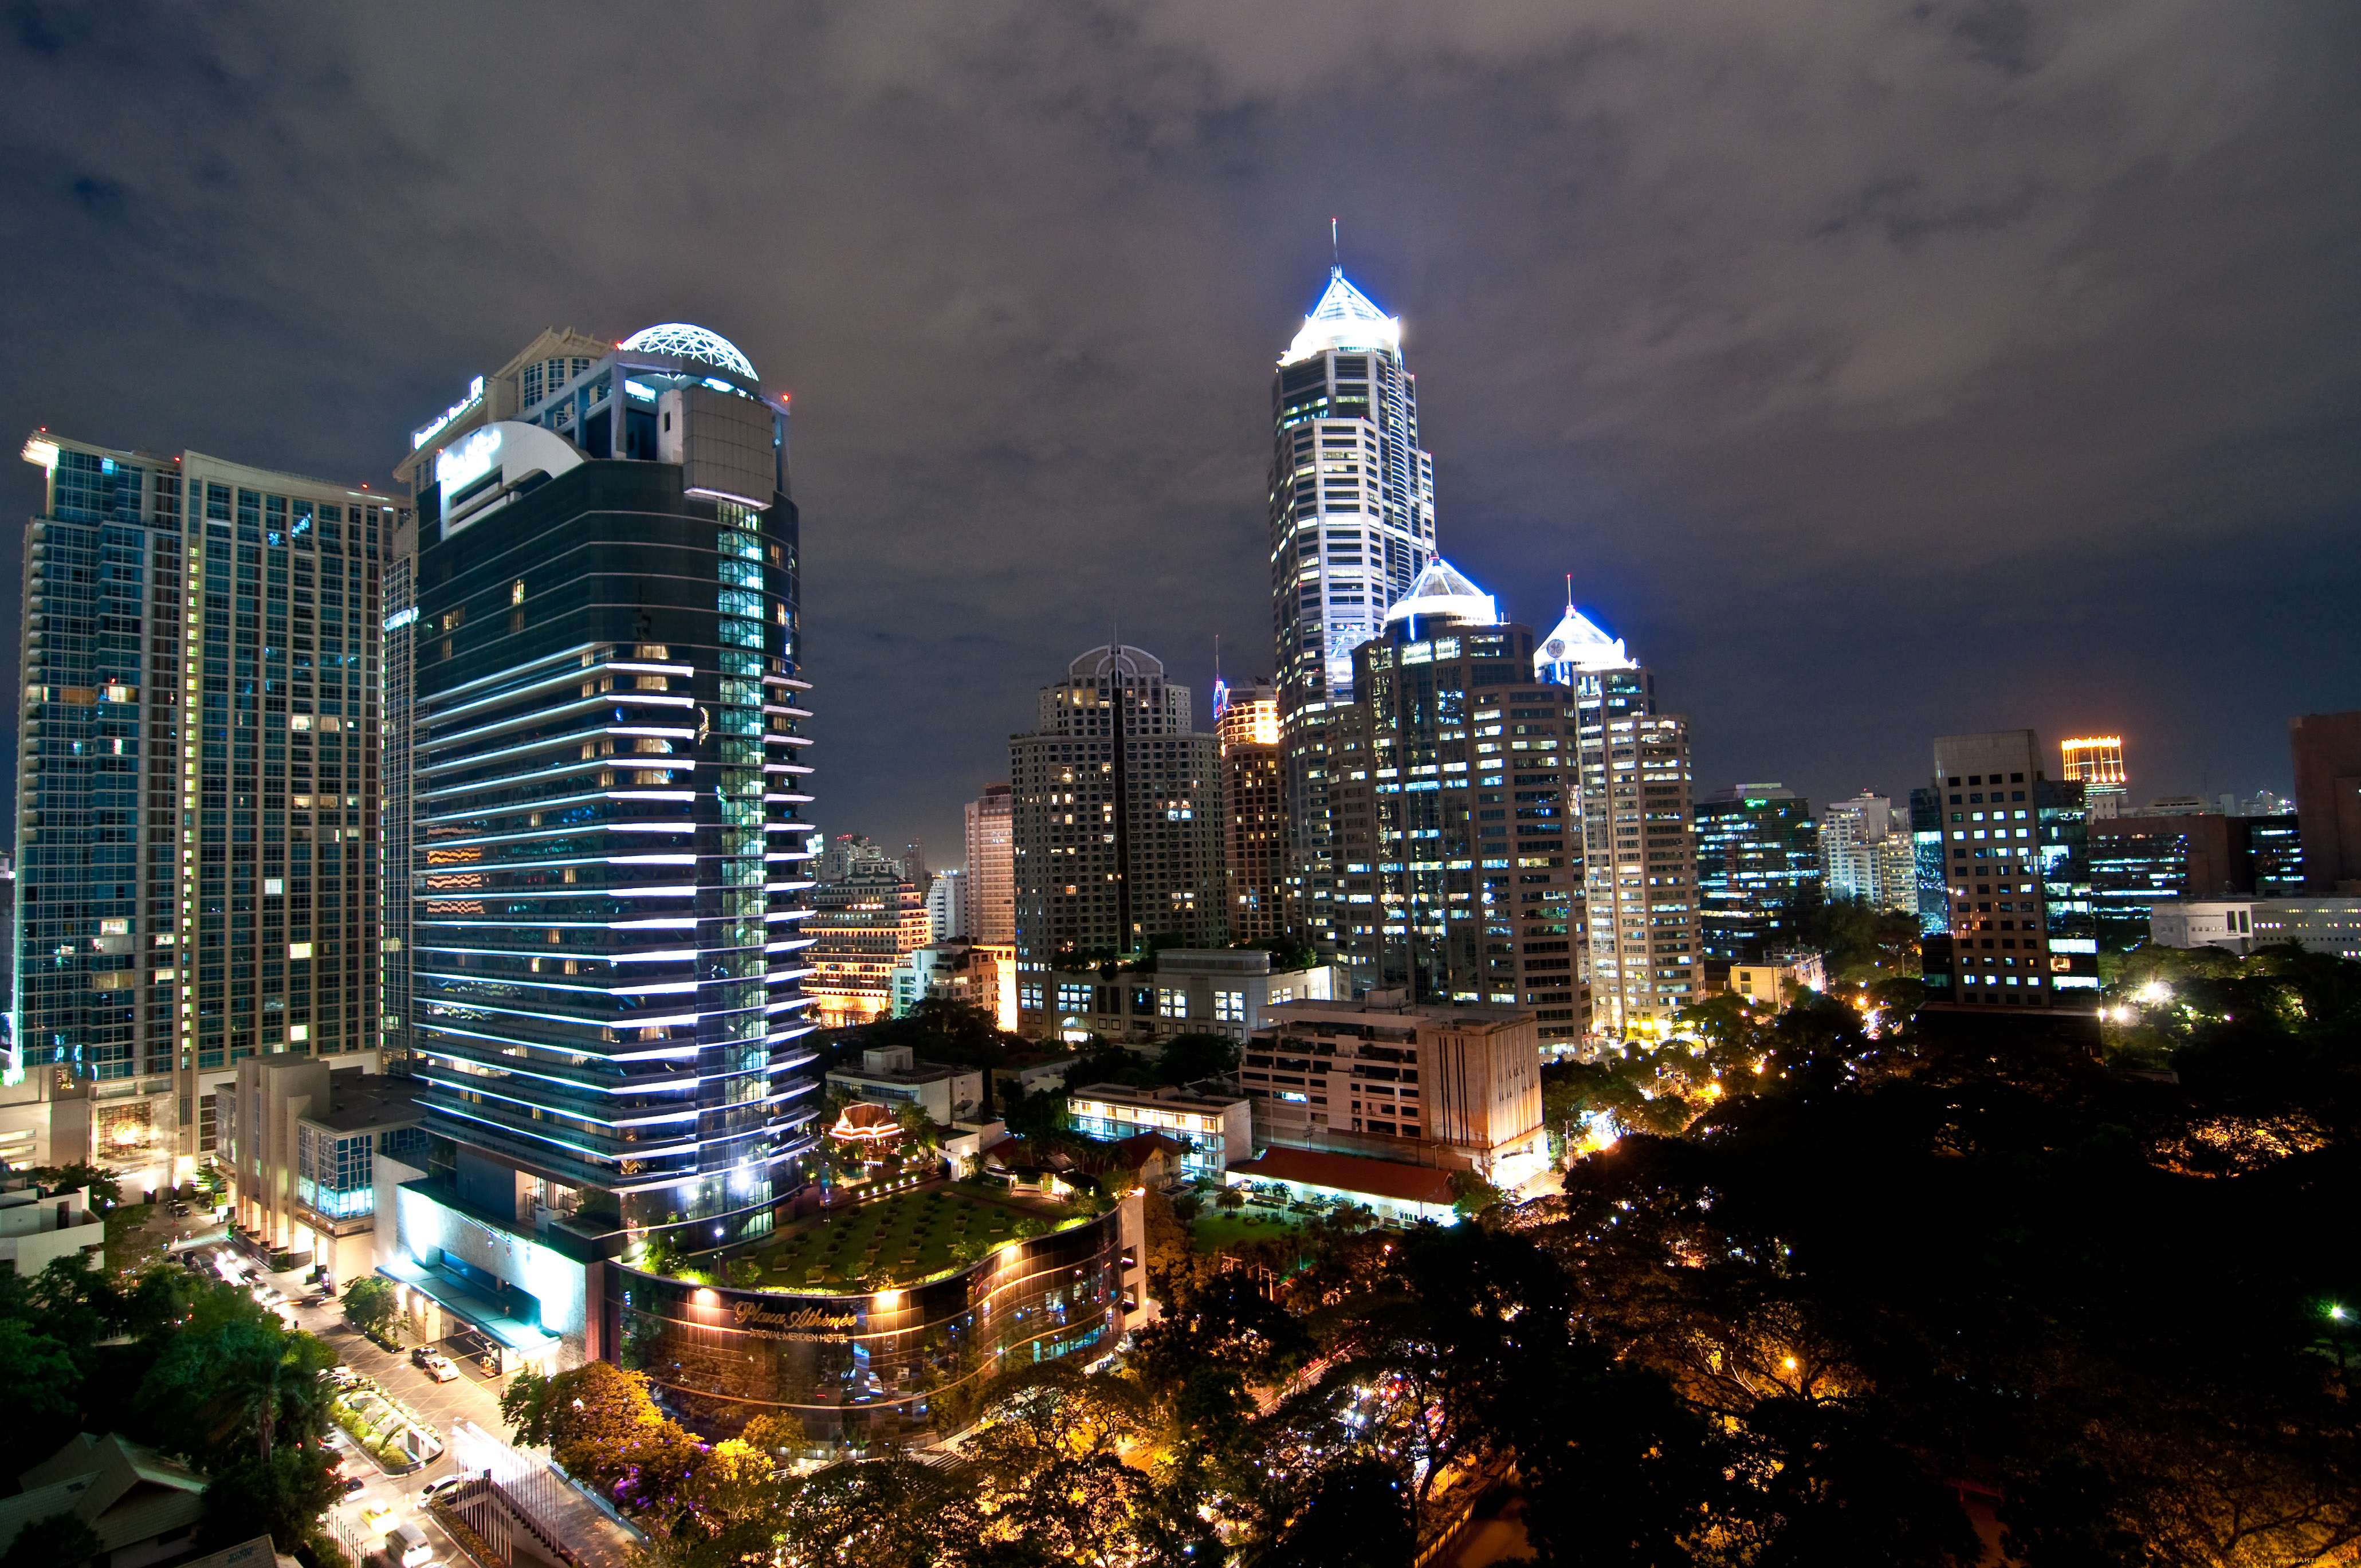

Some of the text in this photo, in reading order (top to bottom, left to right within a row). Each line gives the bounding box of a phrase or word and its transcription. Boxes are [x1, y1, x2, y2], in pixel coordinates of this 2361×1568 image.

[756, 1330, 781, 1340] ROYAL
[782, 1331, 818, 1343] MERIDIEN
[819, 1334, 848, 1343] HOTEL
